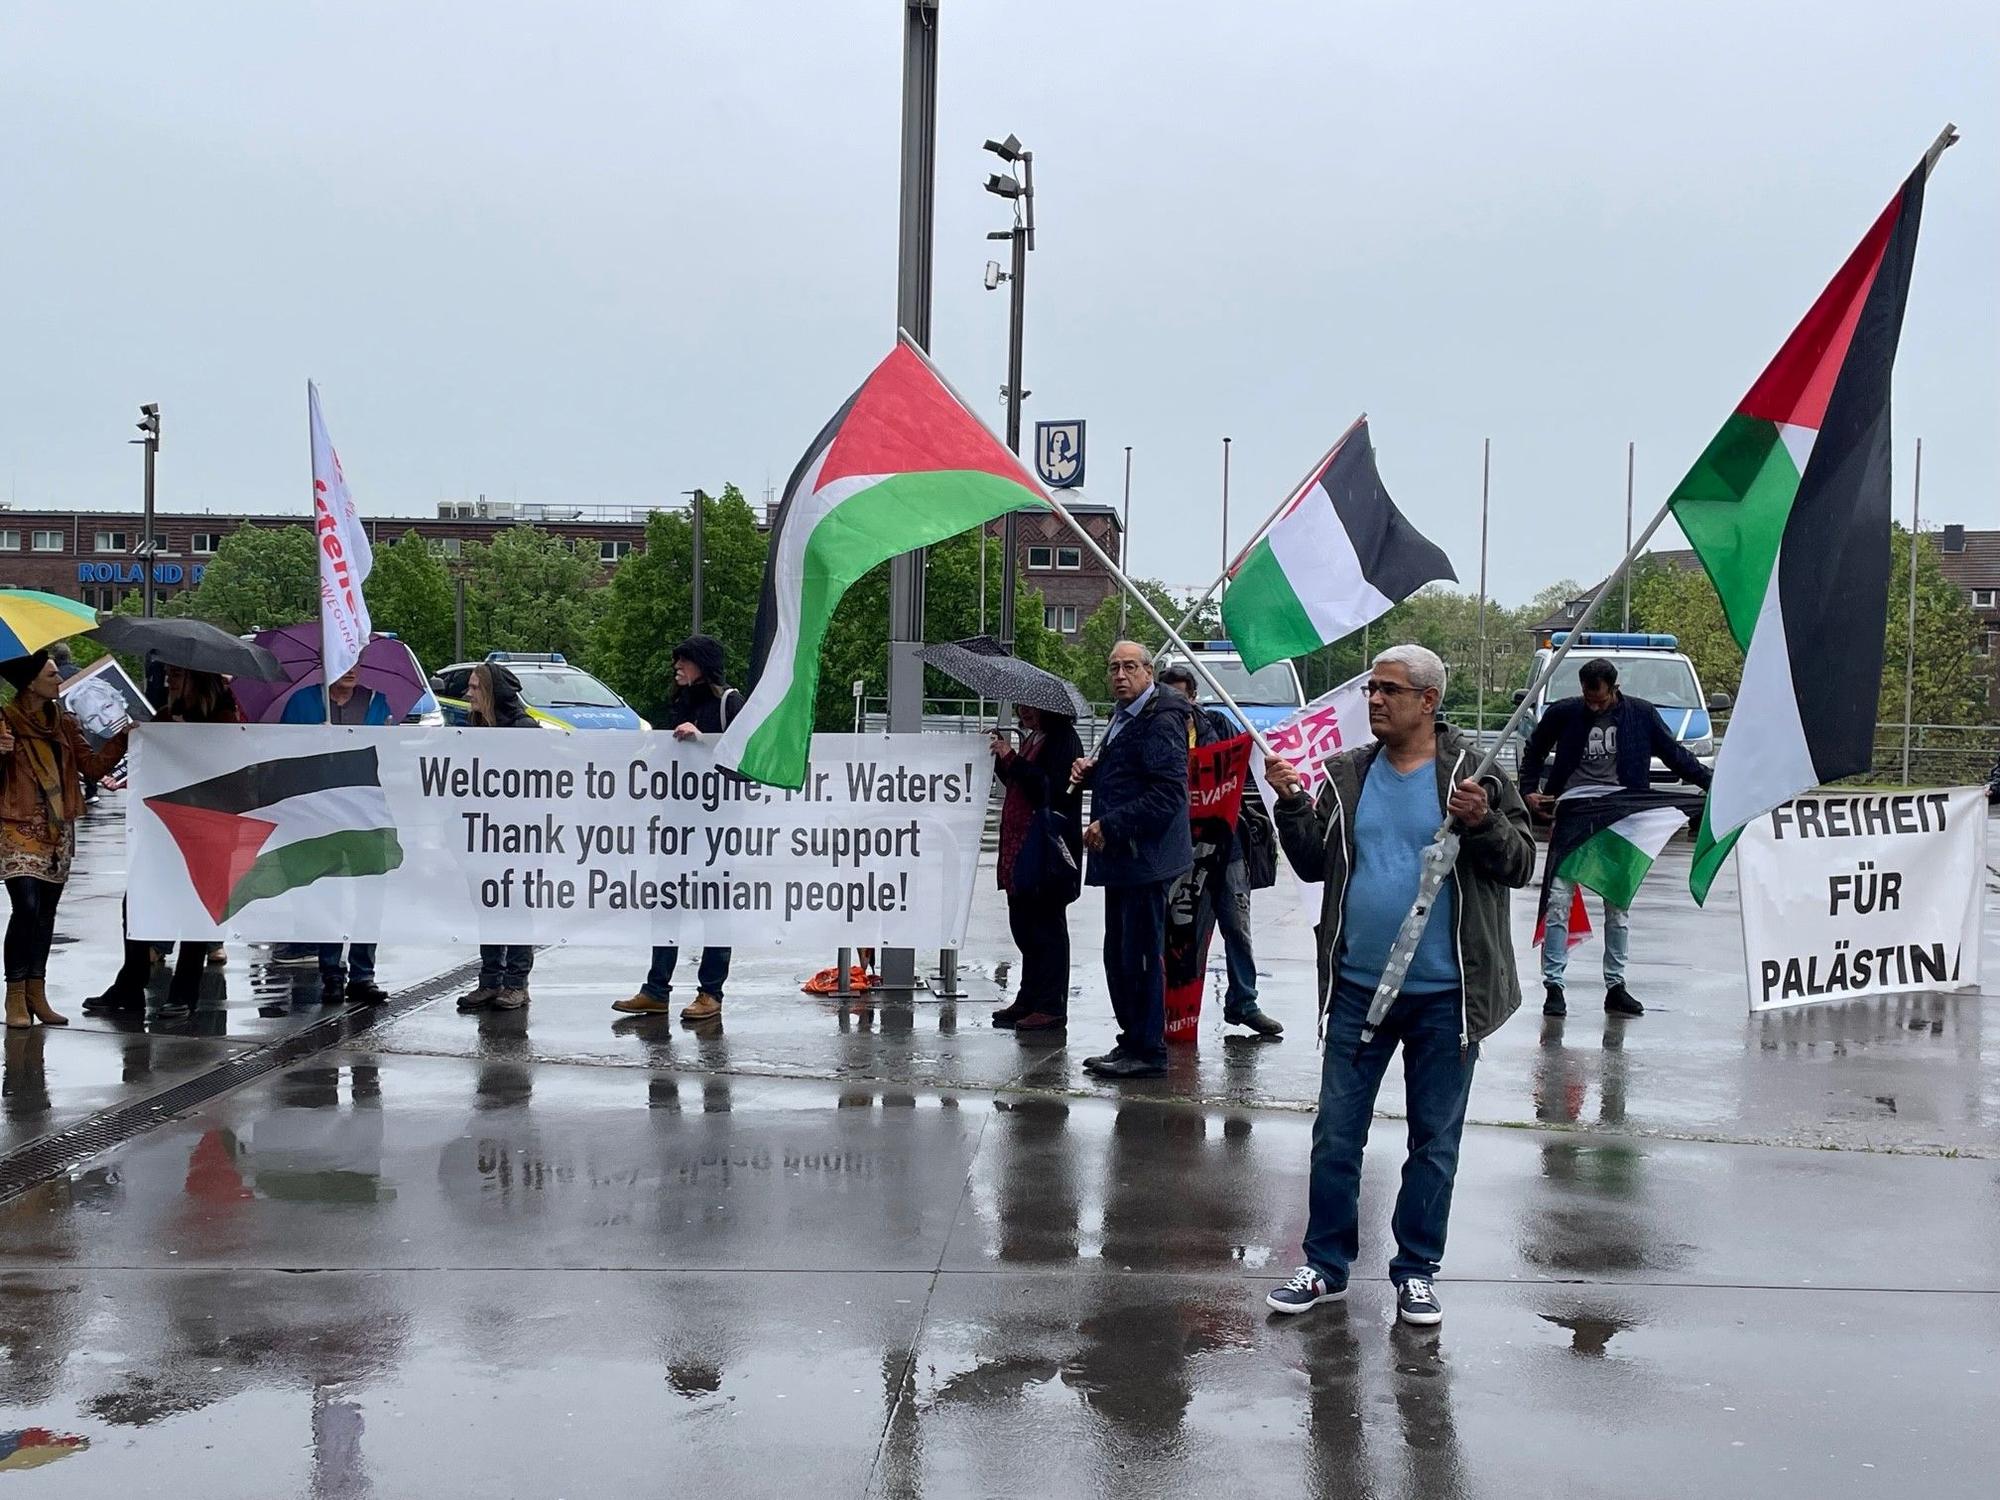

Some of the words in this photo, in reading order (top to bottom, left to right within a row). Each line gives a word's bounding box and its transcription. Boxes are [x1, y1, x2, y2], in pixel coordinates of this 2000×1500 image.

[78, 562, 183, 584] ROLAND
[419, 756, 574, 798] Welcome
[585, 762, 615, 799] to
[846, 762, 973, 802] Waters!
[462, 812, 565, 853] Thank
[576, 825, 635, 864] you
[647, 815, 695, 855] for
[705, 826, 780, 867] your
[791, 820, 921, 867] support
[1771, 793, 1949, 840] FREIHEIT
[481, 868, 514, 907] of
[523, 868, 575, 908] the
[589, 869, 772, 910] Palestinian
[785, 872, 908, 922] people!
[1829, 861, 1902, 916] FÜR
